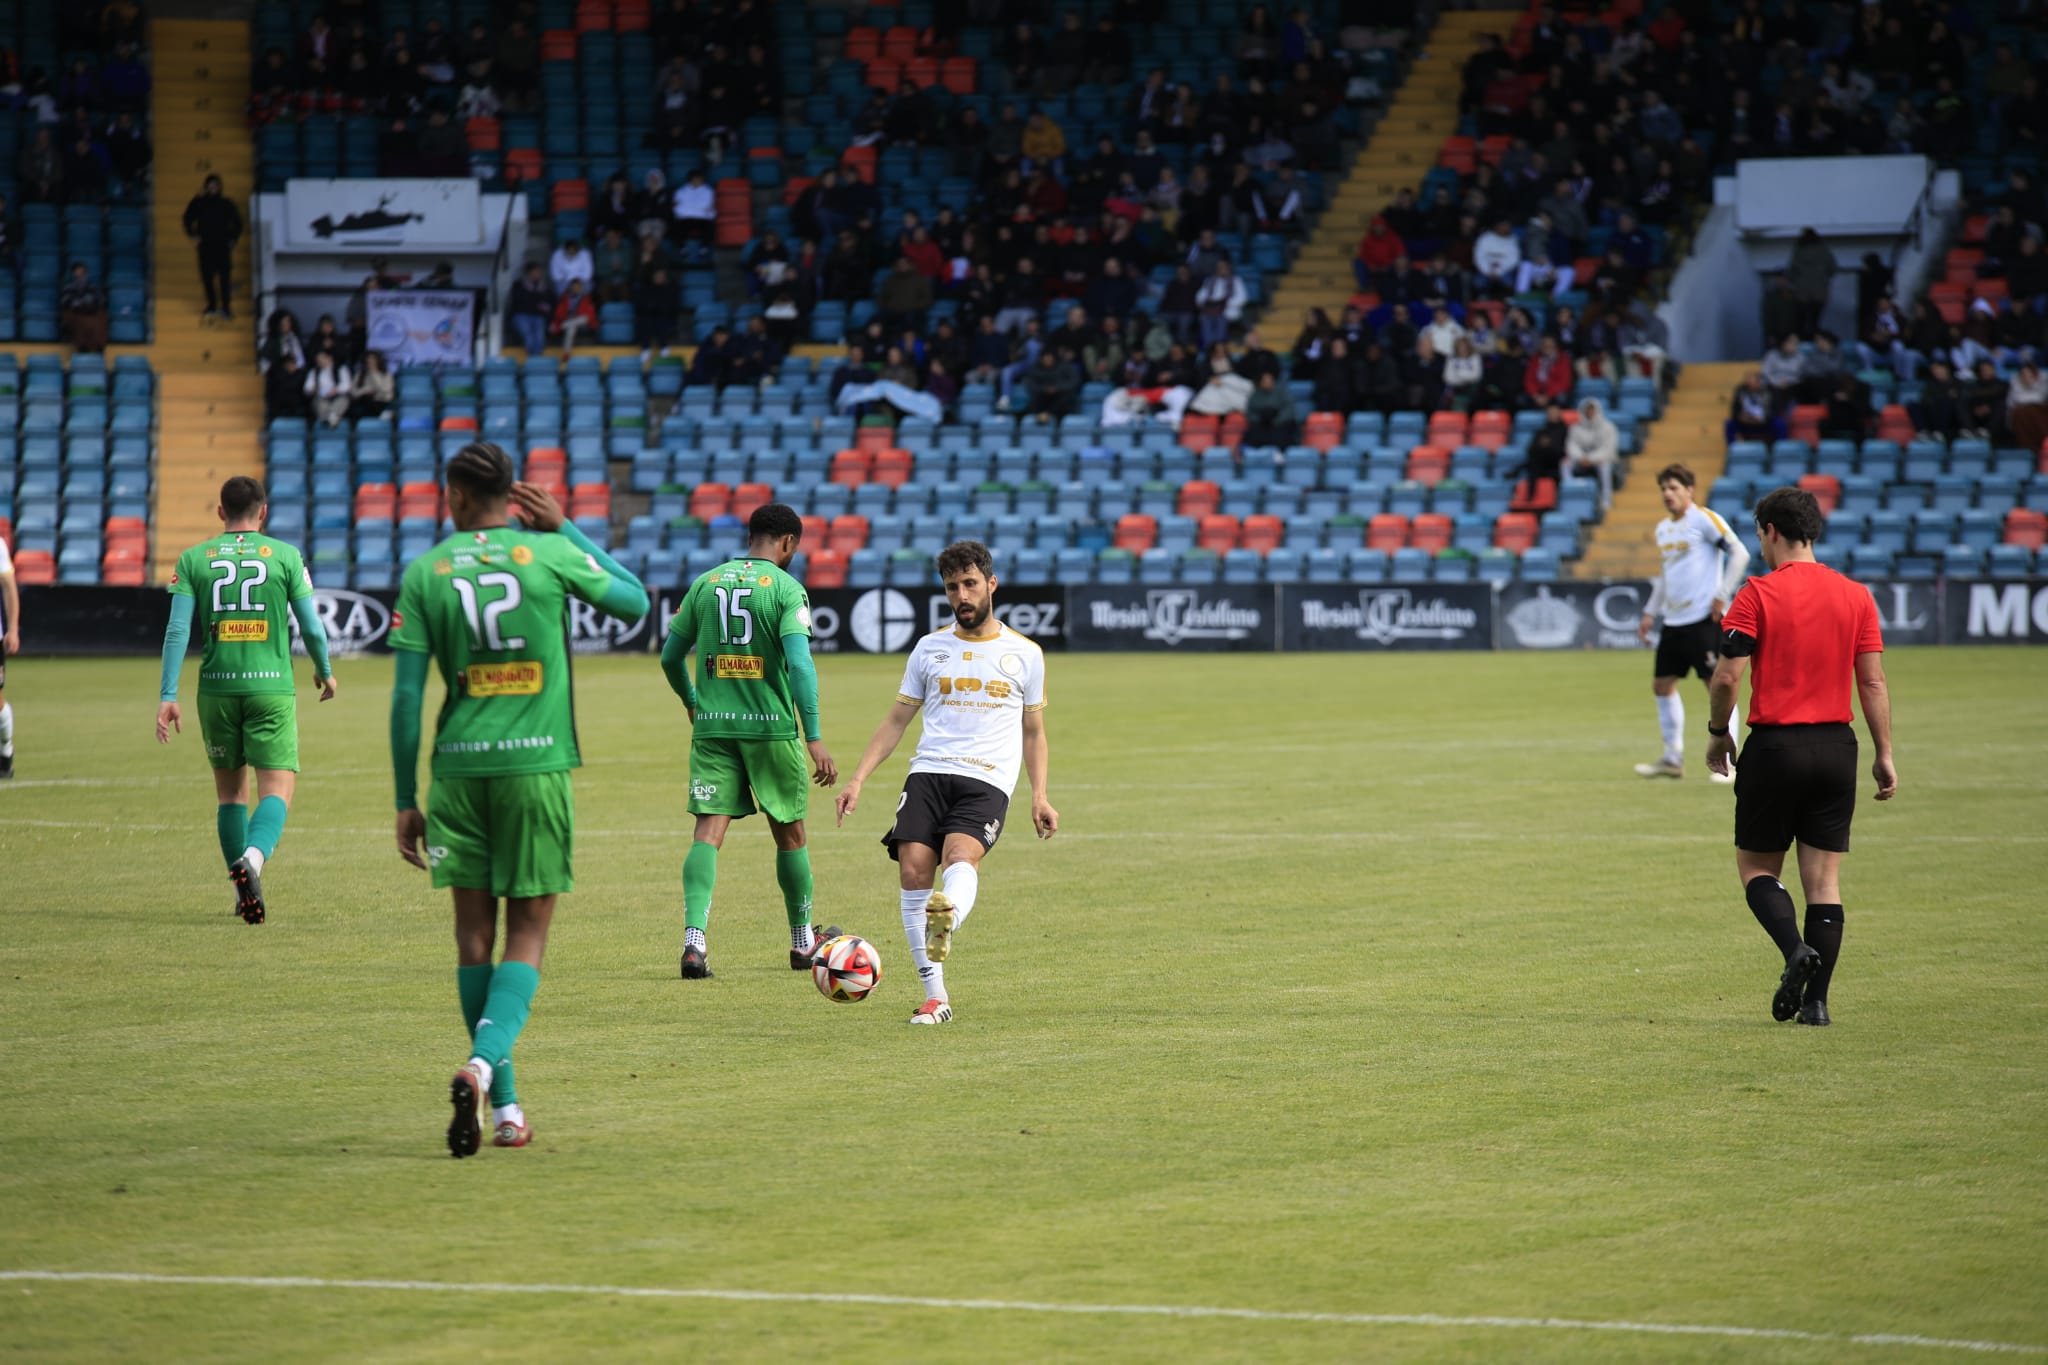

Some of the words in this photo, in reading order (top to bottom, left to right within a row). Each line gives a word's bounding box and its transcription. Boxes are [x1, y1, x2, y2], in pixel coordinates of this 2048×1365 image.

[210, 559, 268, 613] 22
[451, 571, 526, 651] 12
[714, 586, 753, 645] 15
[929, 595, 1060, 636] Prez
